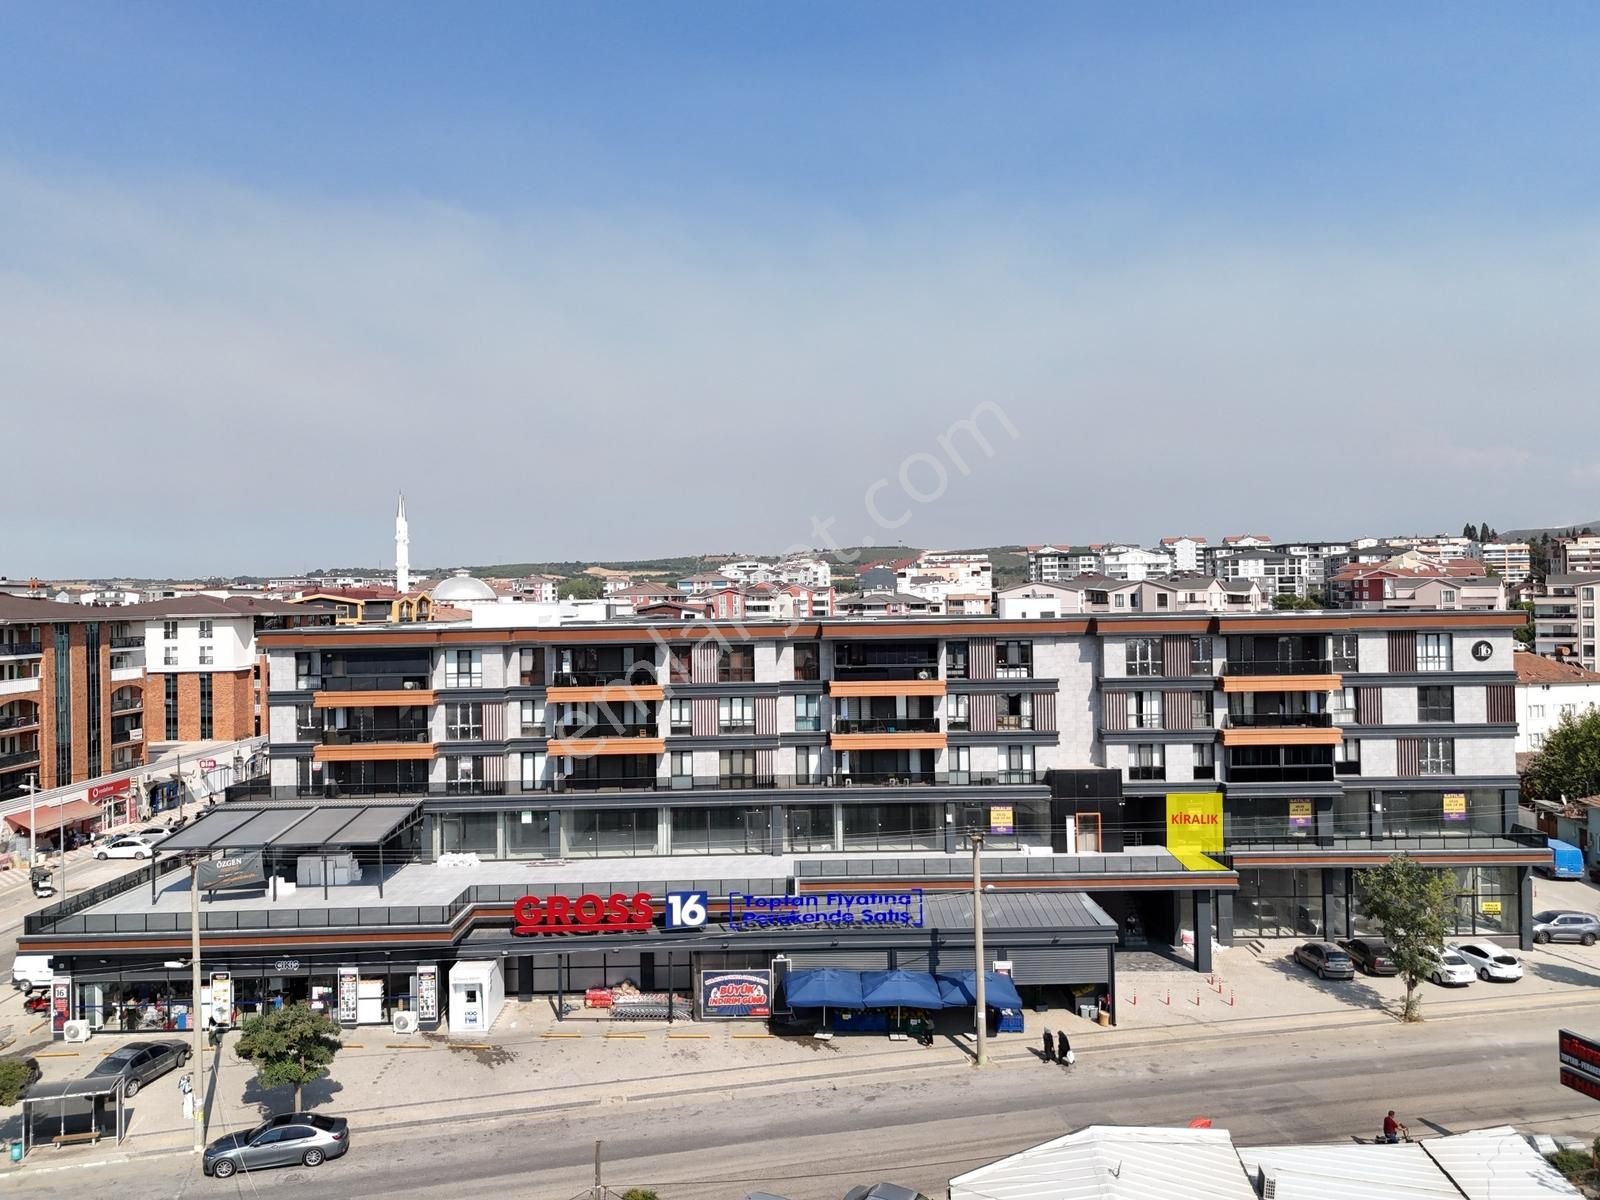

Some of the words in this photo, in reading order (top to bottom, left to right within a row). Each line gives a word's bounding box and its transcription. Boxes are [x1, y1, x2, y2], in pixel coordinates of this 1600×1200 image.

[216, 857, 242, 869] ÖZGEN
[512, 892, 654, 926] GROSS
[668, 894, 706, 926] 16
[719, 983, 756, 996] BÜYÜK
